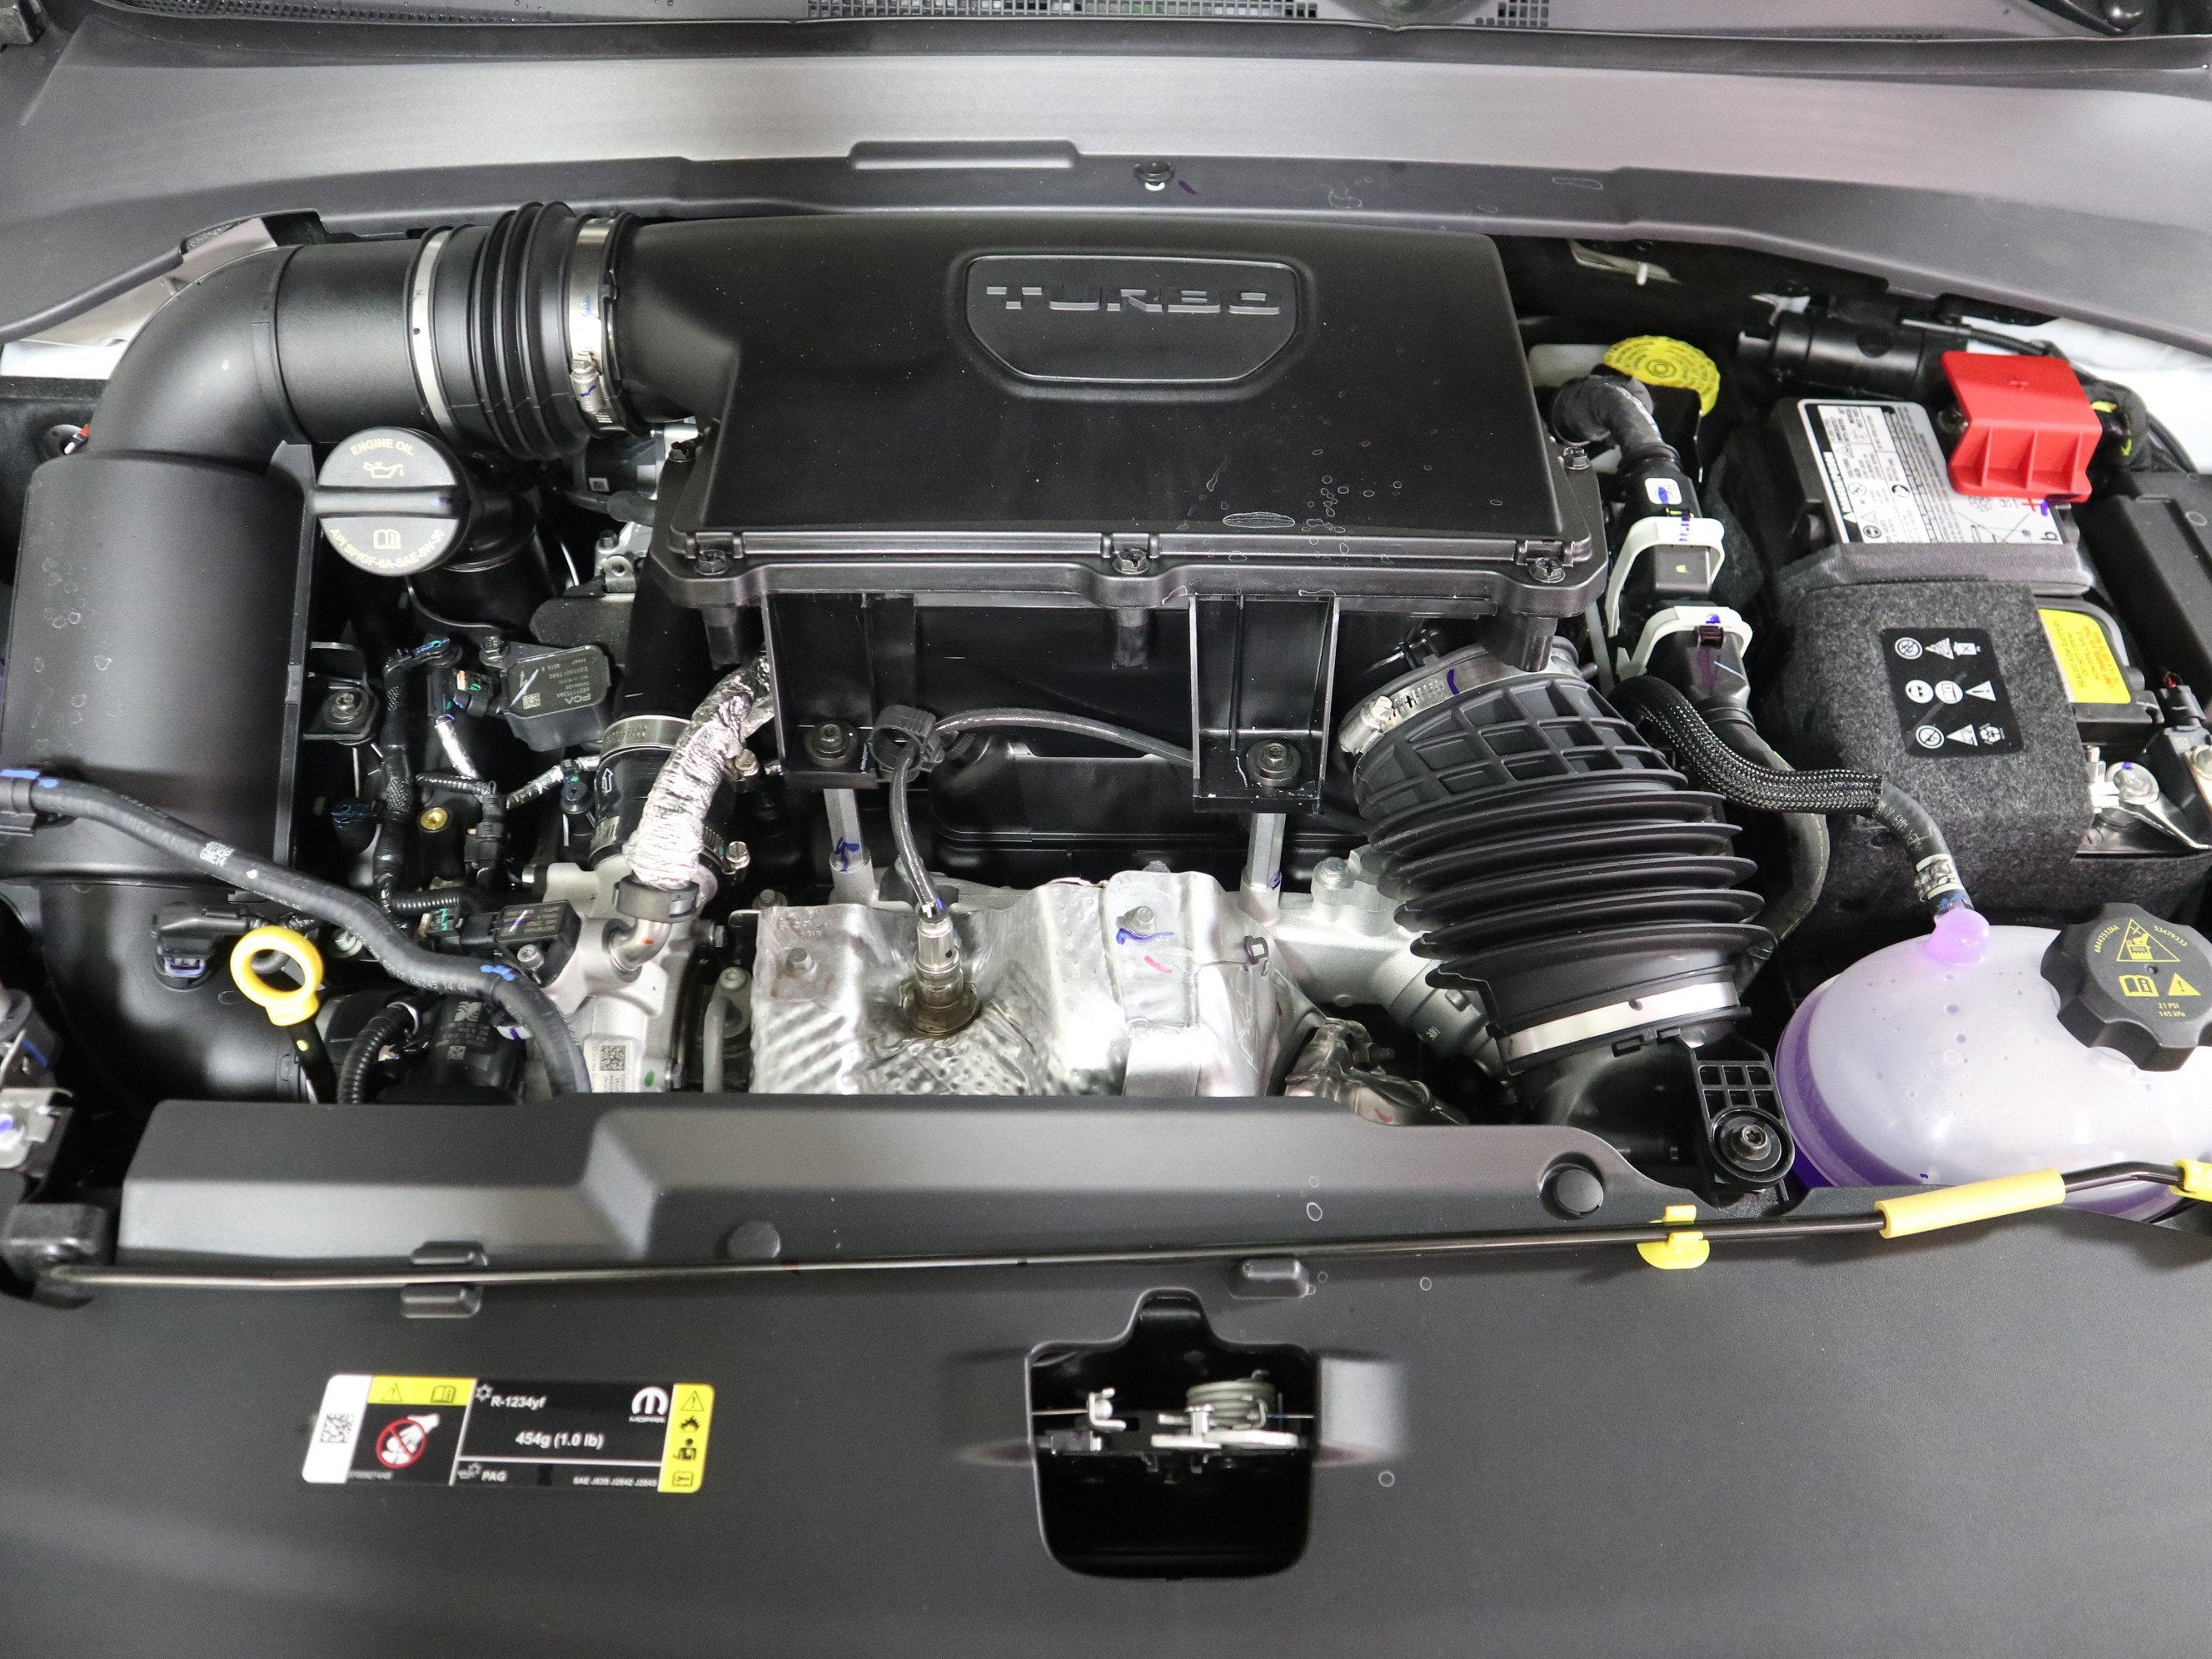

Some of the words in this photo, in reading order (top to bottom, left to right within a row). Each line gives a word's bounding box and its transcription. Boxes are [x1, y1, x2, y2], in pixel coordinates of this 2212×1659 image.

[986, 284, 1280, 315] TURBO
[350, 438, 394, 456] ENGINE
[395, 441, 415, 456] OIL
[329, 528, 346, 547] API
[564, 693, 591, 705] FCA
[491, 1395, 547, 1411] R-1234yf
[516, 1432, 551, 1449] 454g
[554, 1432, 580, 1449] (1.0
[583, 1432, 605, 1450] lb)
[481, 1470, 508, 1482] PAG
